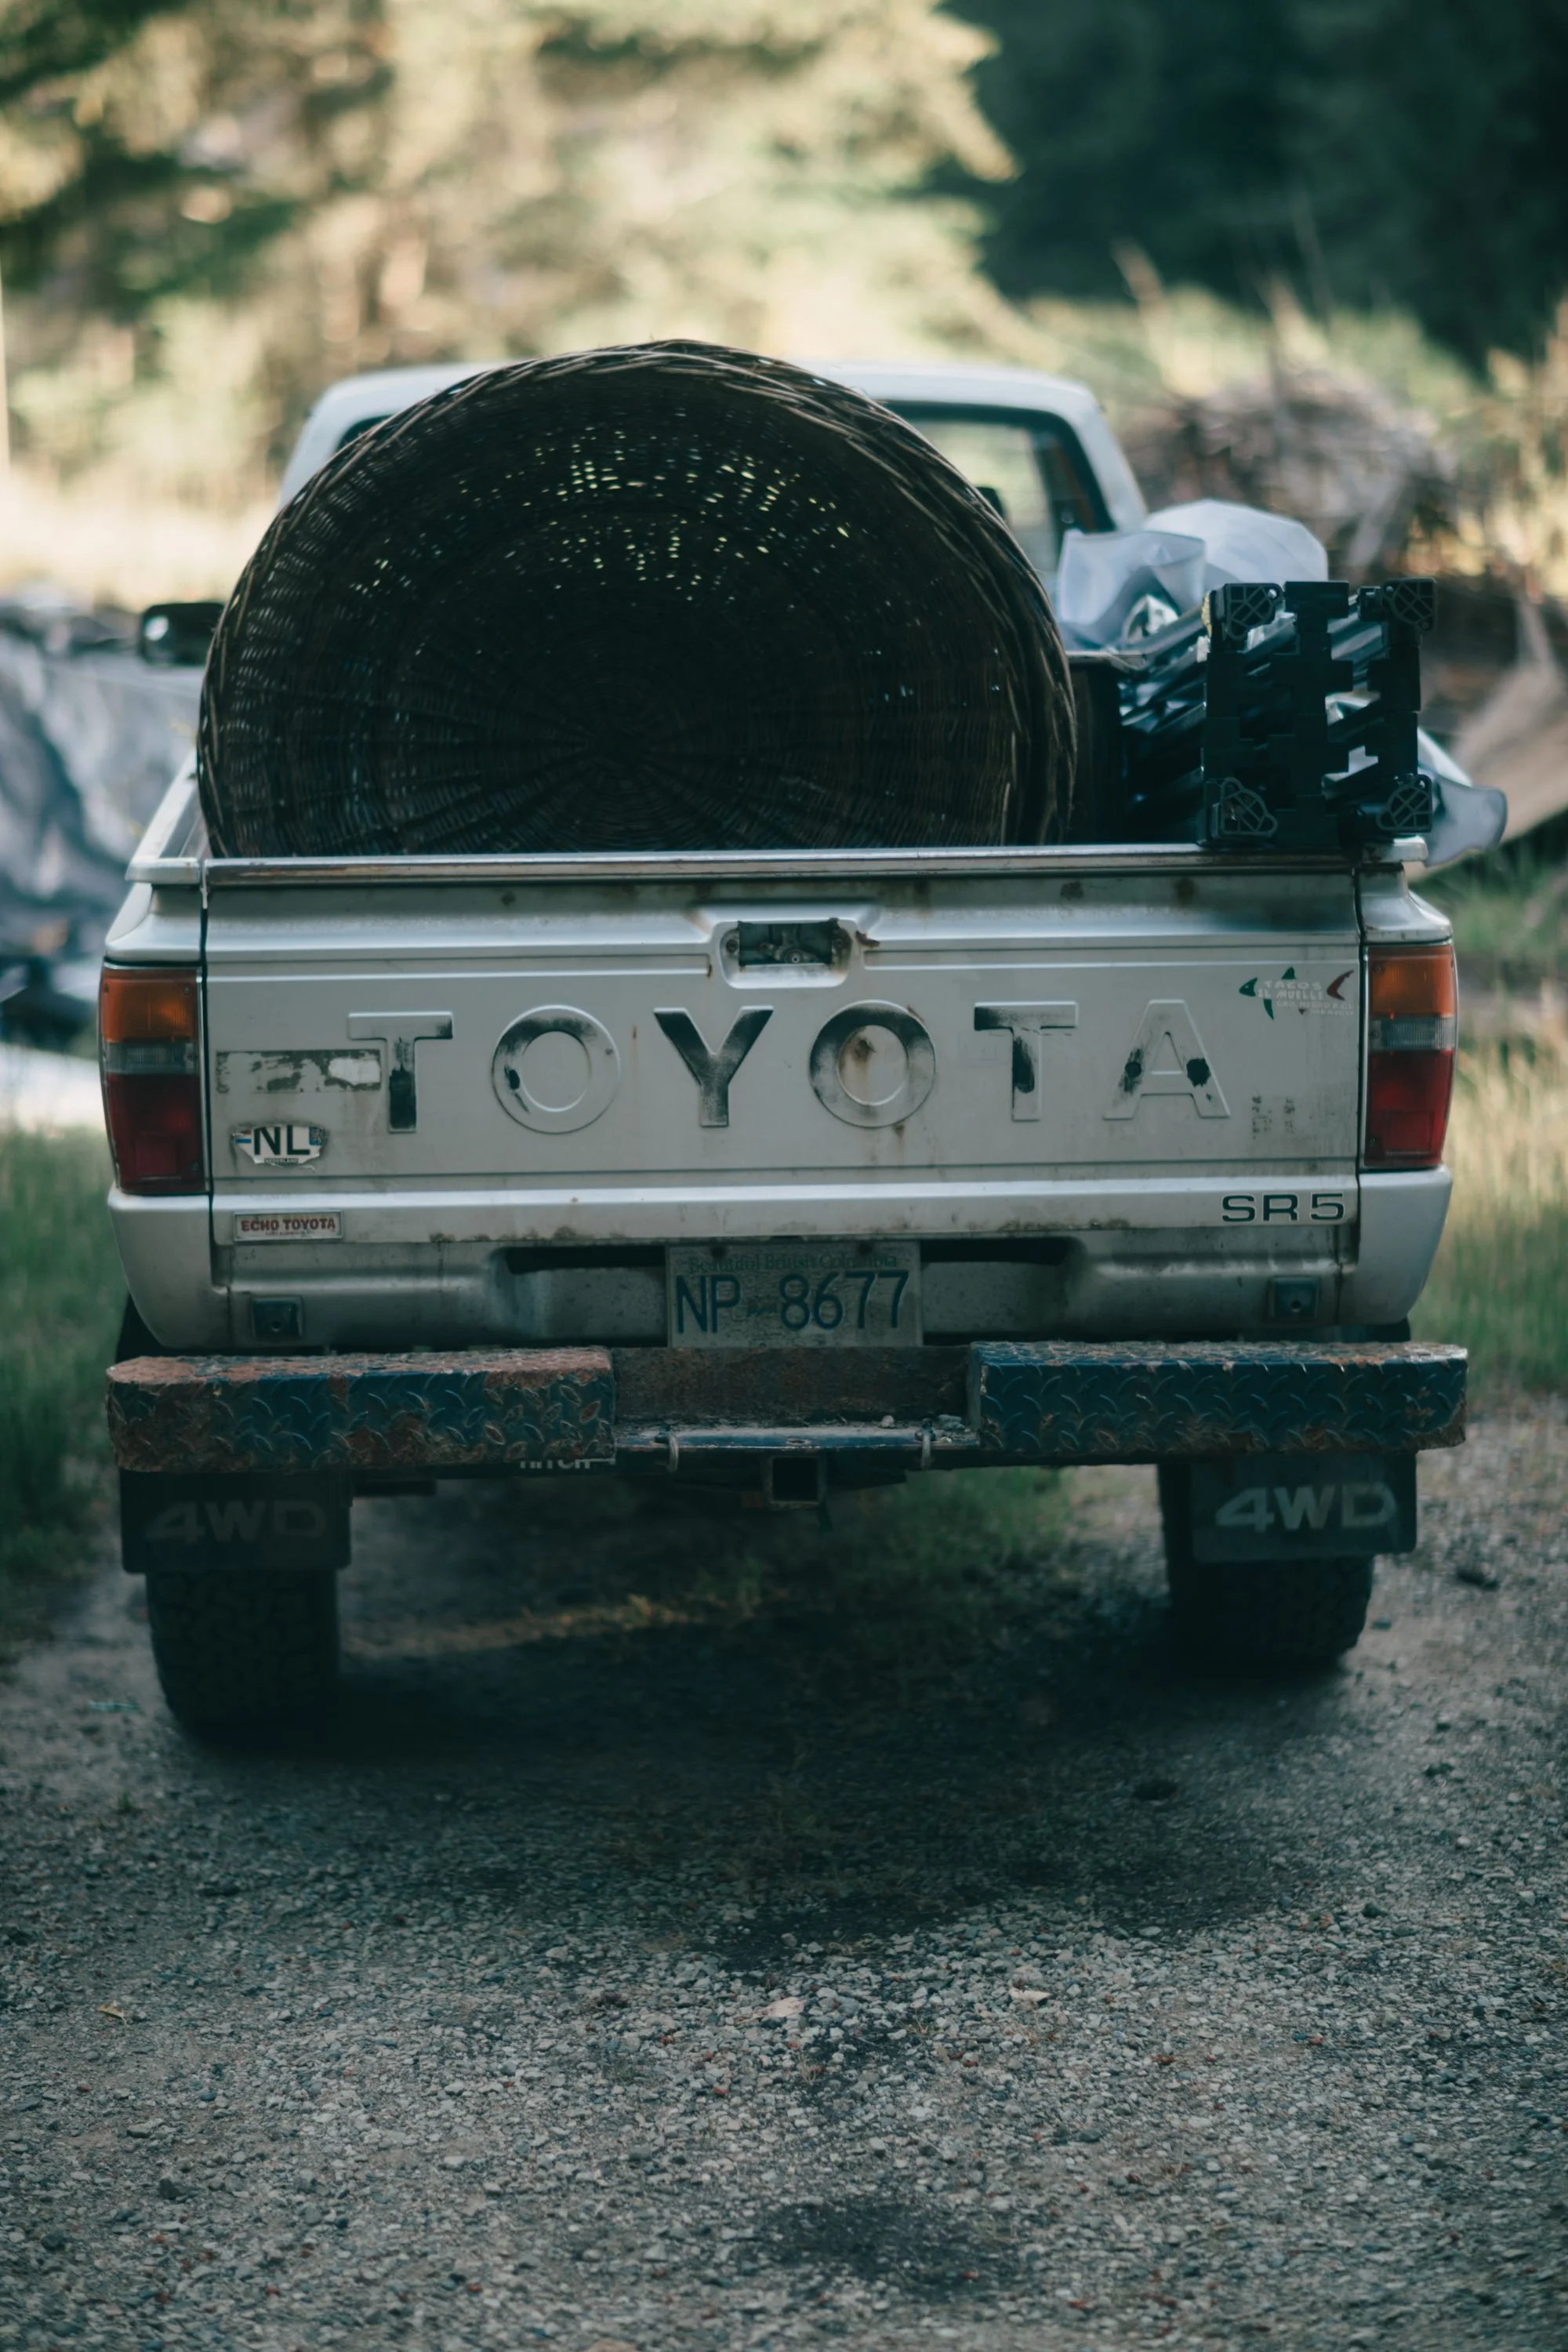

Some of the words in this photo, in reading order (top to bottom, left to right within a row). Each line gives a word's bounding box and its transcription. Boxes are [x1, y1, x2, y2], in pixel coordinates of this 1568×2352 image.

[1264, 979, 1323, 991] TACOS
[1276, 989, 1323, 1001] MUELLE
[349, 999, 1231, 1135] TOYOTA
[254, 1125, 310, 1156] NL
[1221, 1192, 1345, 1223] SR5
[241, 1220, 279, 1232] ECHO
[283, 1218, 336, 1231] TOYOTA
[676, 1272, 742, 1334] NP
[779, 1270, 909, 1330] 8677
[145, 1499, 328, 1544] 4WD
[1215, 1483, 1399, 1533] 4WD
